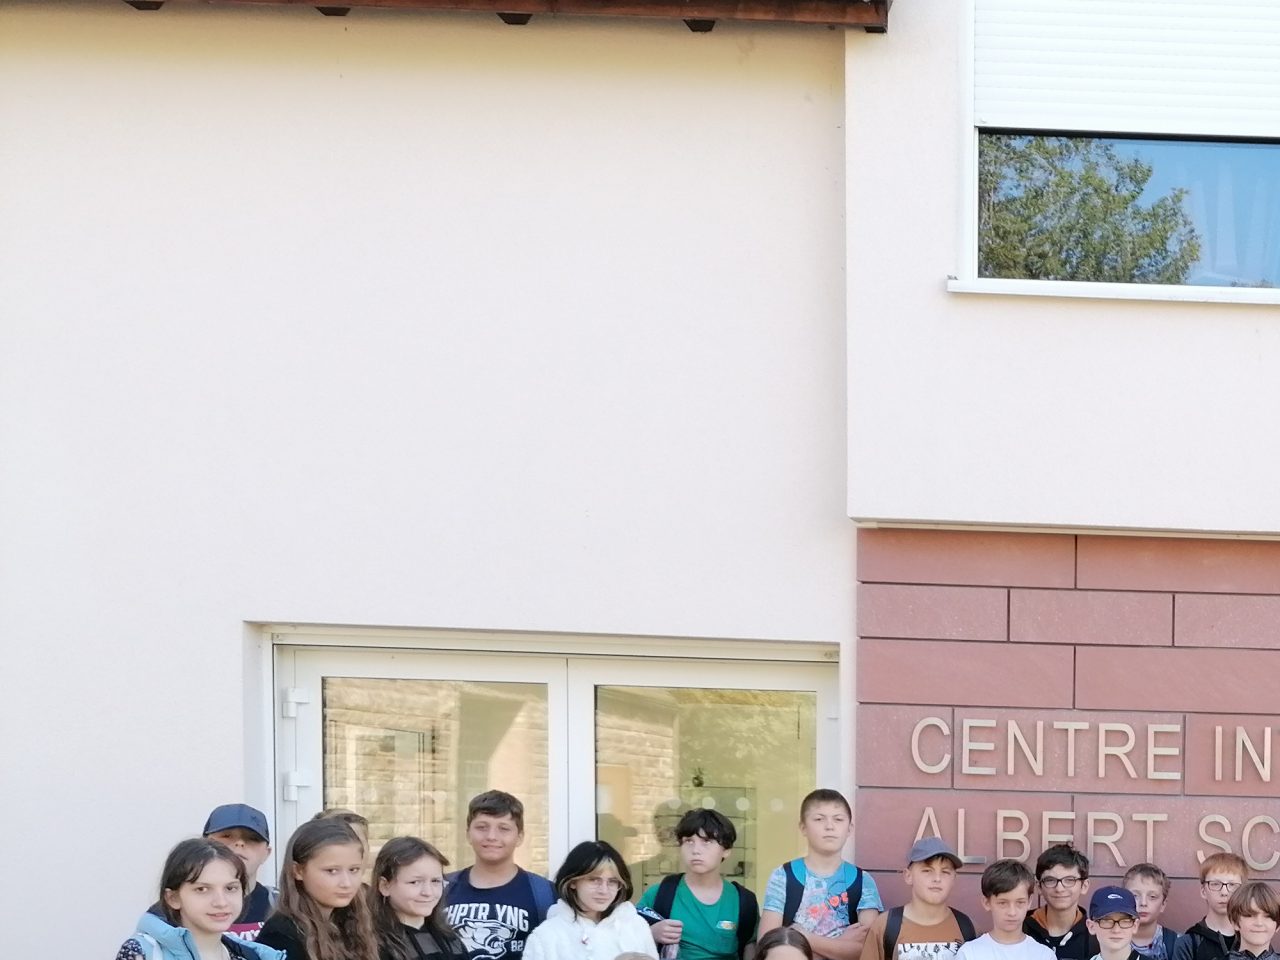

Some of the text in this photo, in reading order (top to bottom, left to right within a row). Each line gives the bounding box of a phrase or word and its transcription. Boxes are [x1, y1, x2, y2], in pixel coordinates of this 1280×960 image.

[911, 716, 1181, 780] CENTRE
[913, 806, 1168, 867] ALBERT
[445, 903, 529, 932] HPTR YNG
